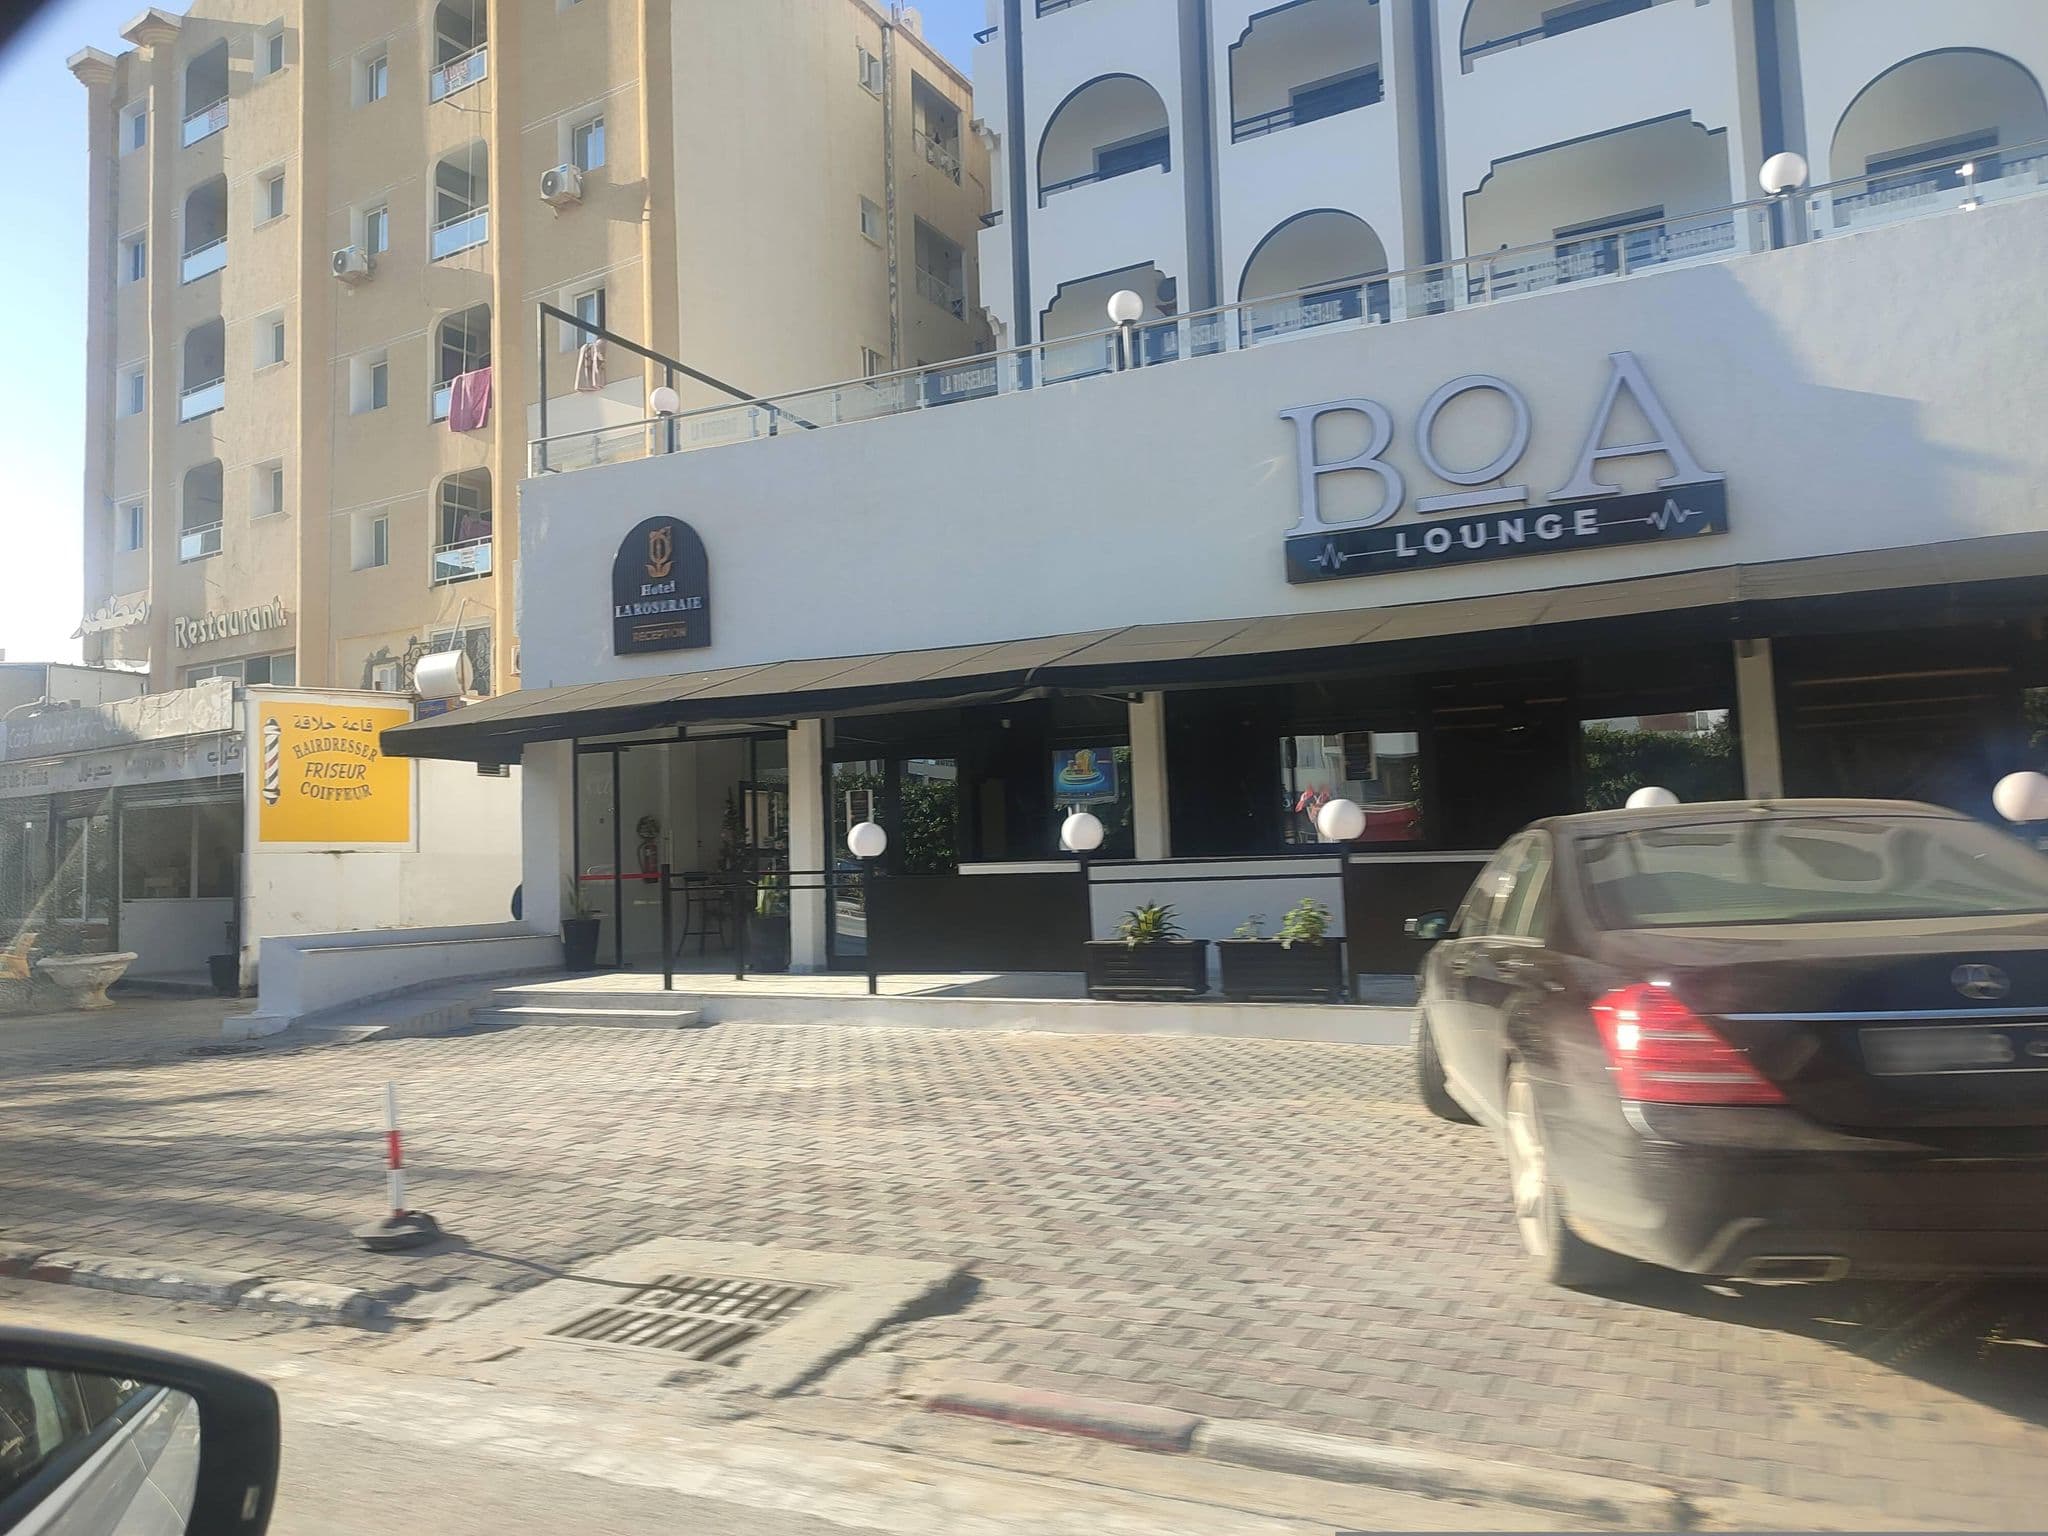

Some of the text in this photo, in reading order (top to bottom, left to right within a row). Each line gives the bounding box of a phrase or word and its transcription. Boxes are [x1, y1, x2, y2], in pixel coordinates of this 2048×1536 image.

[1280, 350, 1727, 539] BOA
[1396, 508, 1600, 559] LOUNGE
[640, 580, 676, 596] Hotel
[174, 595, 288, 649] Restaurant
[293, 715, 372, 732] قاعة حلاقة
[292, 737, 378, 762] HAIRDRESSER
[304, 762, 366, 780] FRISEUR
[300, 781, 372, 801] COIFFEUR
